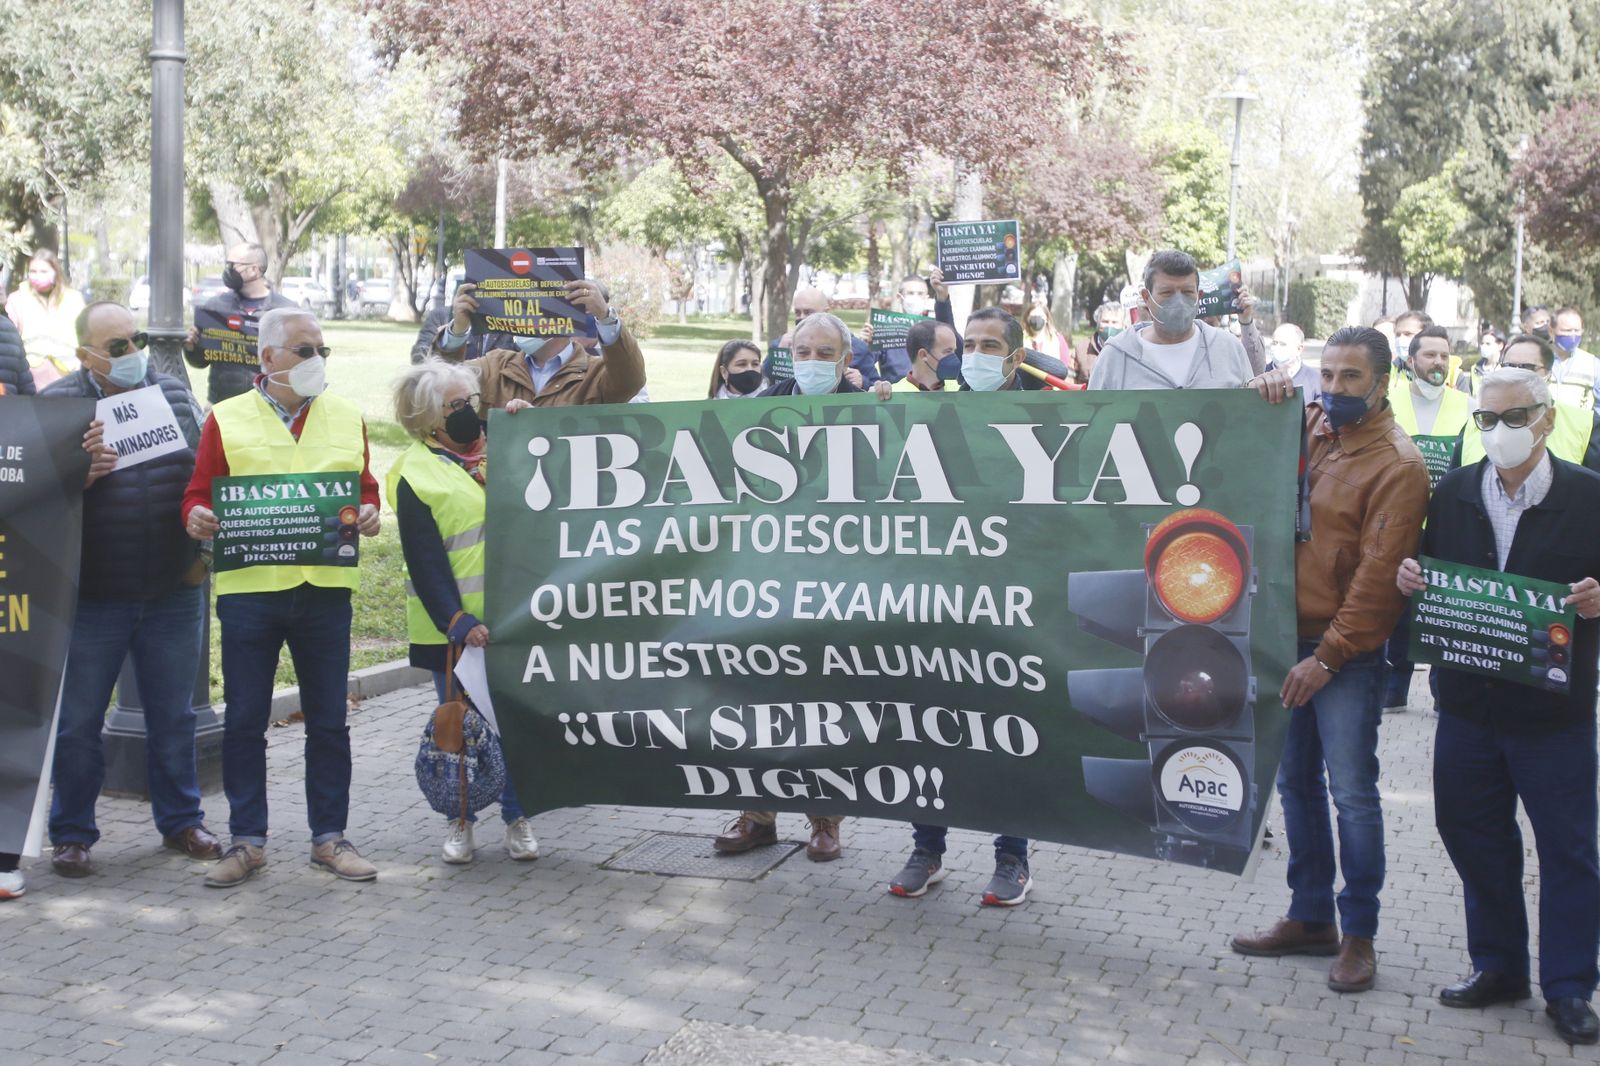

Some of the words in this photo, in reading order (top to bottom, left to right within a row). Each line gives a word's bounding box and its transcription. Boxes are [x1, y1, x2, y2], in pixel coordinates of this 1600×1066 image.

[979, 224, 996, 235] YA!
[954, 237, 993, 245] AUTOESCUELAS
[942, 246, 969, 255] QUEREMOS
[946, 254, 971, 262] NUESTROS
[960, 262, 996, 270] SERVICIO
[485, 279, 530, 289] AUTOESCUELAS
[504, 299, 522, 316] NO
[526, 299, 544, 316] AL
[486, 316, 535, 334] SISTEMA
[538, 317, 575, 335] CAPA
[222, 341, 234, 352] NO
[237, 344, 248, 354] AL
[204, 349, 244, 364] SISTEMA
[245, 355, 258, 365] CA
[112, 401, 138, 424] MÁS
[109, 424, 178, 458] MINADORES
[1416, 440, 1448, 452] STA
[6, 446, 24, 461] DE
[524, 423, 965, 511] ¡BASTA
[987, 422, 1204, 506] YA!
[1424, 458, 1450, 467] EXAMINA
[1426, 465, 1448, 473] ALUMN
[0, 467, 24, 483] OBA
[220, 483, 310, 502] ¡BASTA
[314, 481, 352, 497] YA!
[224, 508, 242, 517] LAS
[244, 504, 316, 516] AUTOESCUELAS
[220, 518, 271, 530] QUEREMOS
[272, 516, 320, 526] EXAMINAR
[218, 531, 225, 540] A
[226, 528, 274, 538] NUESTROS
[276, 526, 322, 536] ALUMNOS
[559, 518, 642, 558] LAS
[653, 514, 1009, 558] AUTOESCUELAS
[251, 541, 317, 552] SERVICIO
[244, 553, 296, 562] DIGNO!!
[1423, 568, 1520, 604] ¡BASTA
[1523, 588, 1566, 615] YA!
[530, 578, 782, 630] QUEREMOS
[792, 580, 1034, 627] EXAMINAR
[1424, 592, 1443, 603] LAS
[1444, 594, 1524, 619] AUTOESCUELAS
[1418, 603, 1474, 621] QUEREMOS
[1475, 614, 1528, 633] EXAMINAR
[1415, 614, 1424, 623] A
[1425, 616, 1477, 634] NUESTROS
[1479, 626, 1529, 645] ALUMNOS
[1452, 640, 1524, 663] SERVICIO
[522, 645, 556, 684] A
[568, 641, 808, 682] NUESTROS
[822, 644, 1046, 692] ALUMNOS
[1442, 651, 1501, 671] DIGNO!!
[558, 708, 692, 750] ¡¡UN
[710, 701, 1039, 757] SERVICIO
[676, 764, 945, 810] DIGNO!!
[1178, 774, 1228, 798] Apac
